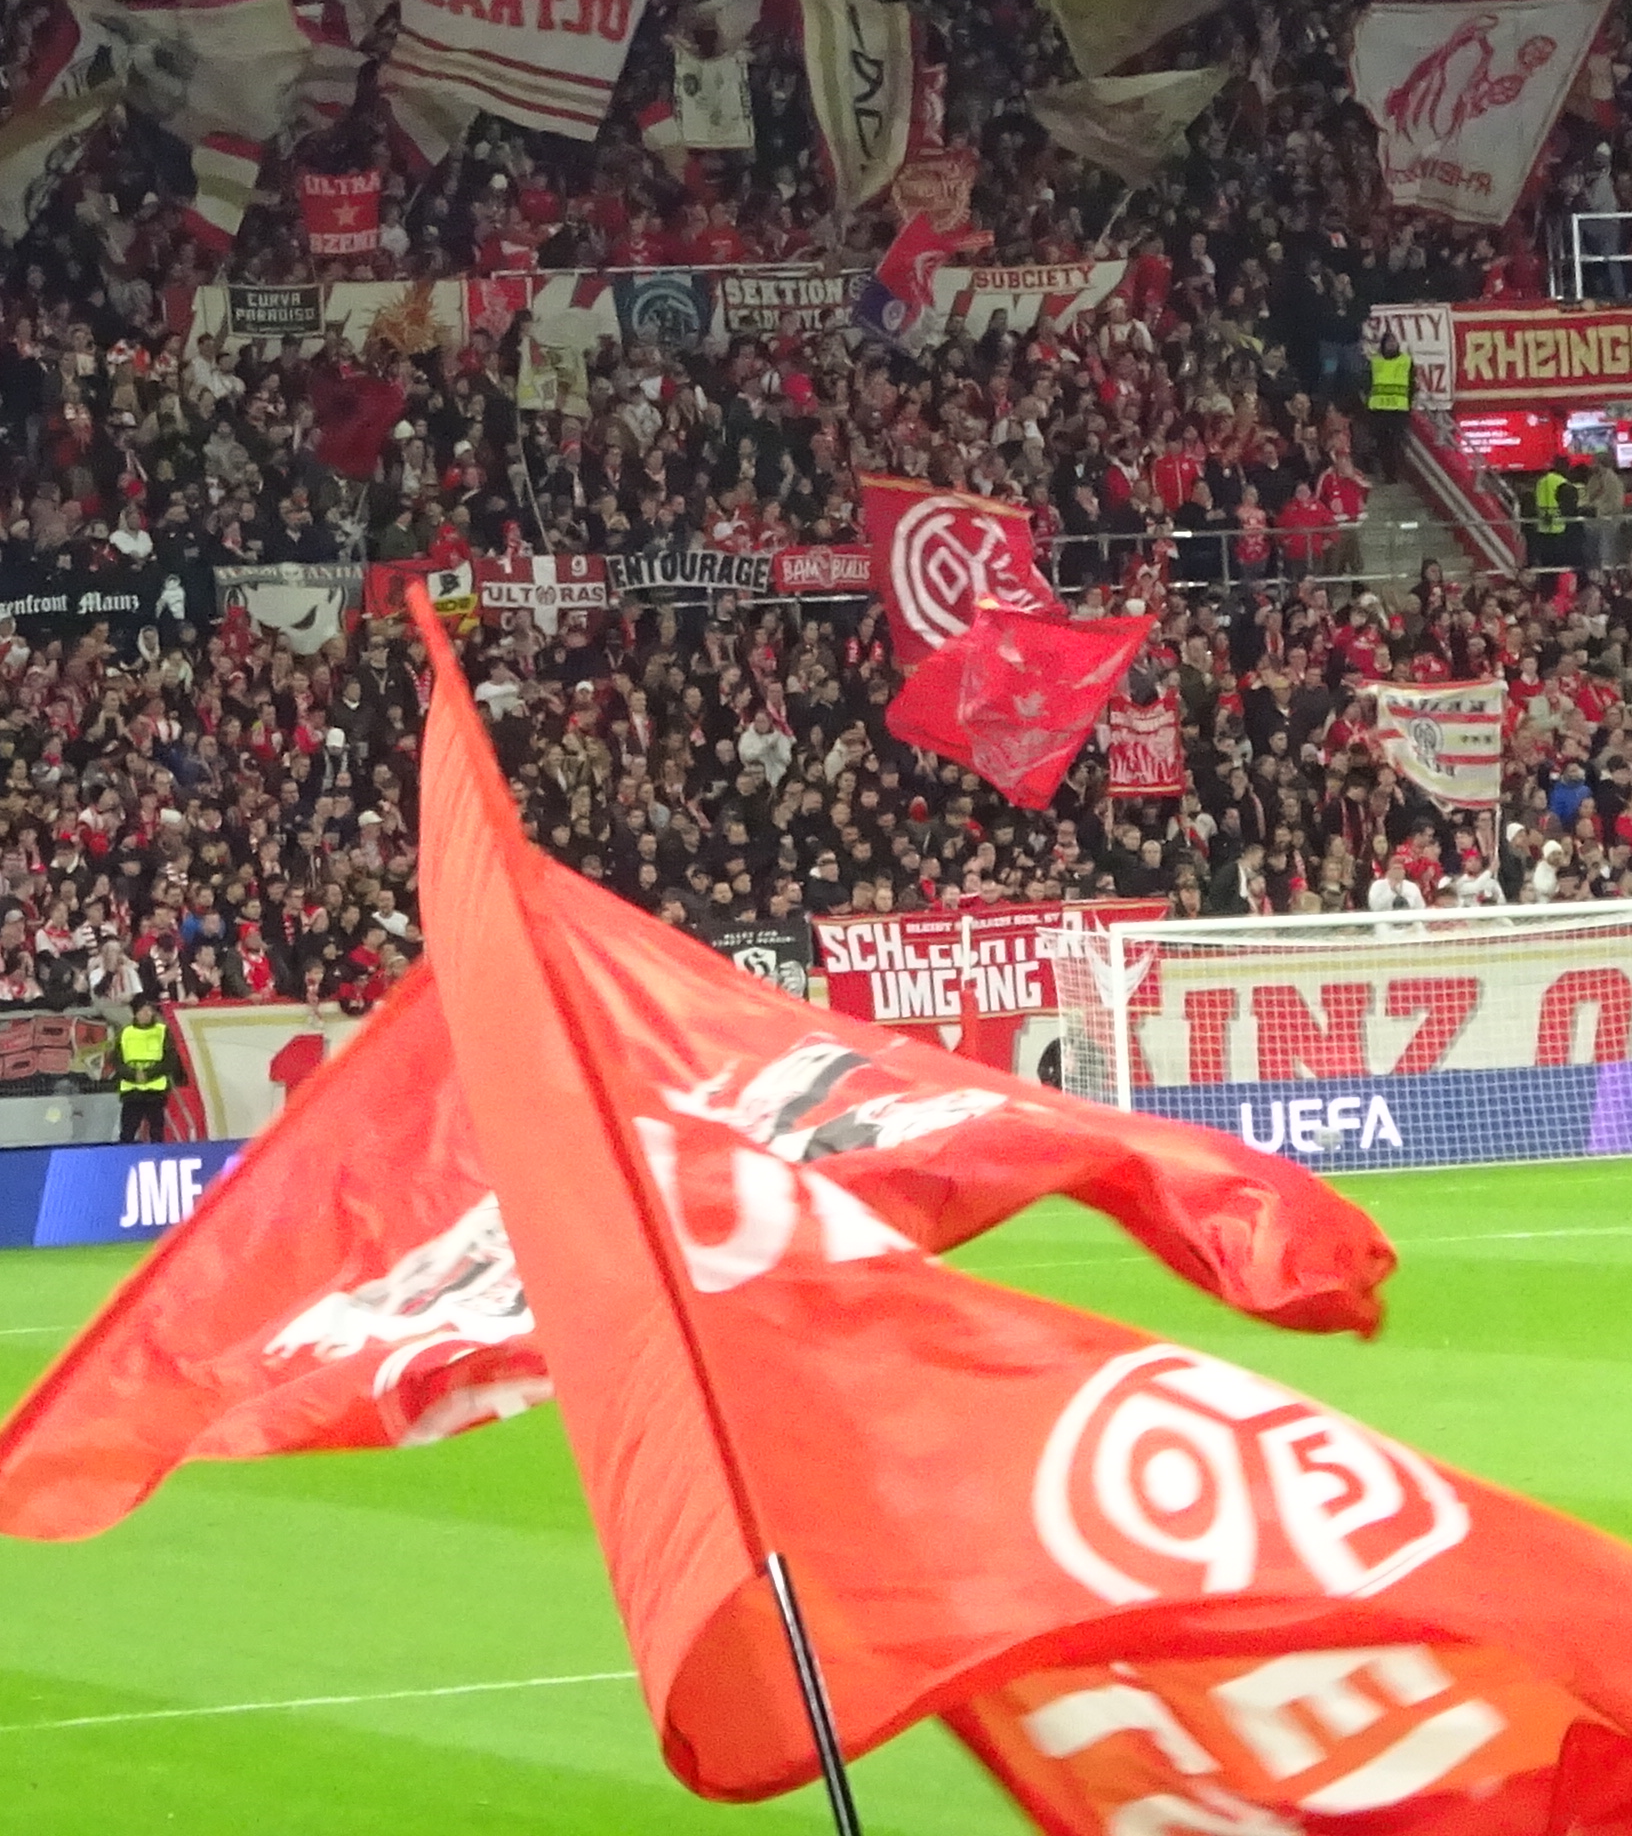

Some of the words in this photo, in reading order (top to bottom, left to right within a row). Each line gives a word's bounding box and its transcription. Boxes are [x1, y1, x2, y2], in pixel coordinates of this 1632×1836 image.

[724, 276, 844, 305] SEKTION
[973, 267, 1093, 291] SUBCIETY
[247, 292, 302, 307] CURVA
[234, 307, 316, 322] PARADISO
[613, 550, 771, 592] ENTOURAGE
[77, 591, 140, 615] Mainz
[1241, 1094, 1403, 1154] UEFA
